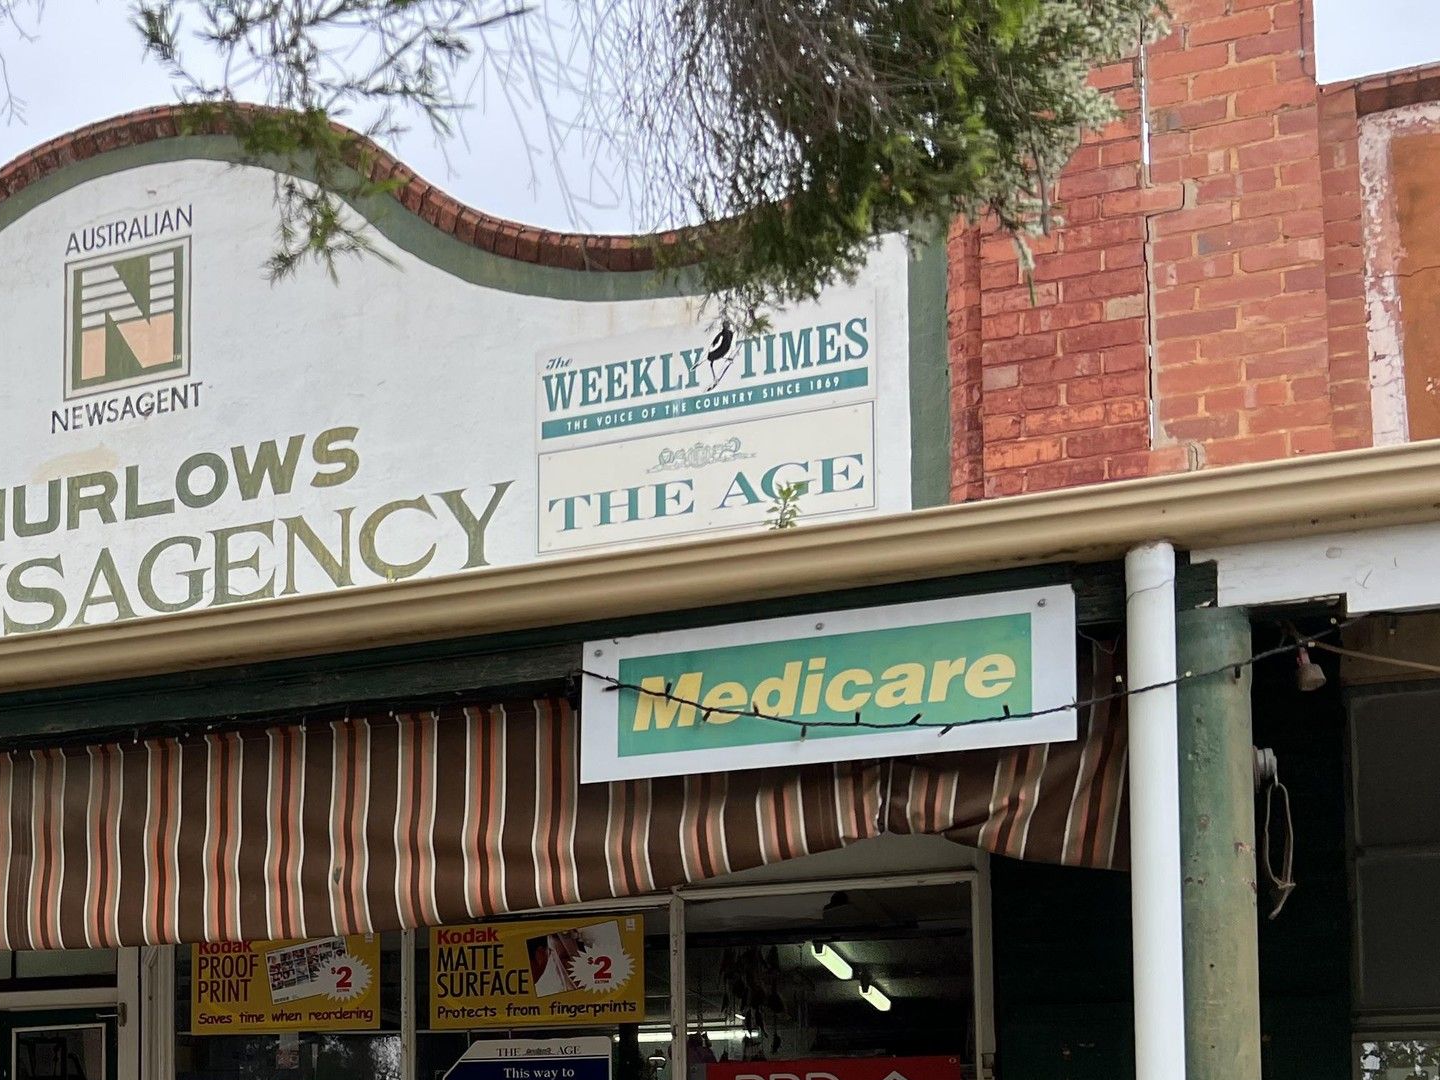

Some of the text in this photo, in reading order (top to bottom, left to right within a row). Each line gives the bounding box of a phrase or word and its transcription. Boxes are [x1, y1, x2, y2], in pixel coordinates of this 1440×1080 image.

[65, 204, 193, 257] AUSTRALIAN
[542, 317, 869, 412] WEEKLY TIMES
[546, 356, 573, 371] The
[51, 381, 203, 434] NEWSAGENT
[566, 375, 840, 432] THE VOICE OF THE COUNTRY SINCE 1869
[548, 453, 865, 533] THE AGE
[632, 652, 1018, 732] Medicare
[198, 940, 252, 955] Kodak
[437, 927, 499, 944] Kodak
[198, 954, 258, 979] PROOF
[437, 944, 504, 972] MATTE
[587, 956, 612, 980] $2
[198, 979, 251, 1003] PRINT
[437, 969, 529, 998] SURFACE
[198, 1007, 373, 1025] Saves time when reordering
[437, 1001, 637, 1019] Protects from fingerprints
[496, 1046, 581, 1057] THE AGE
[504, 1067, 575, 1079] This way to
